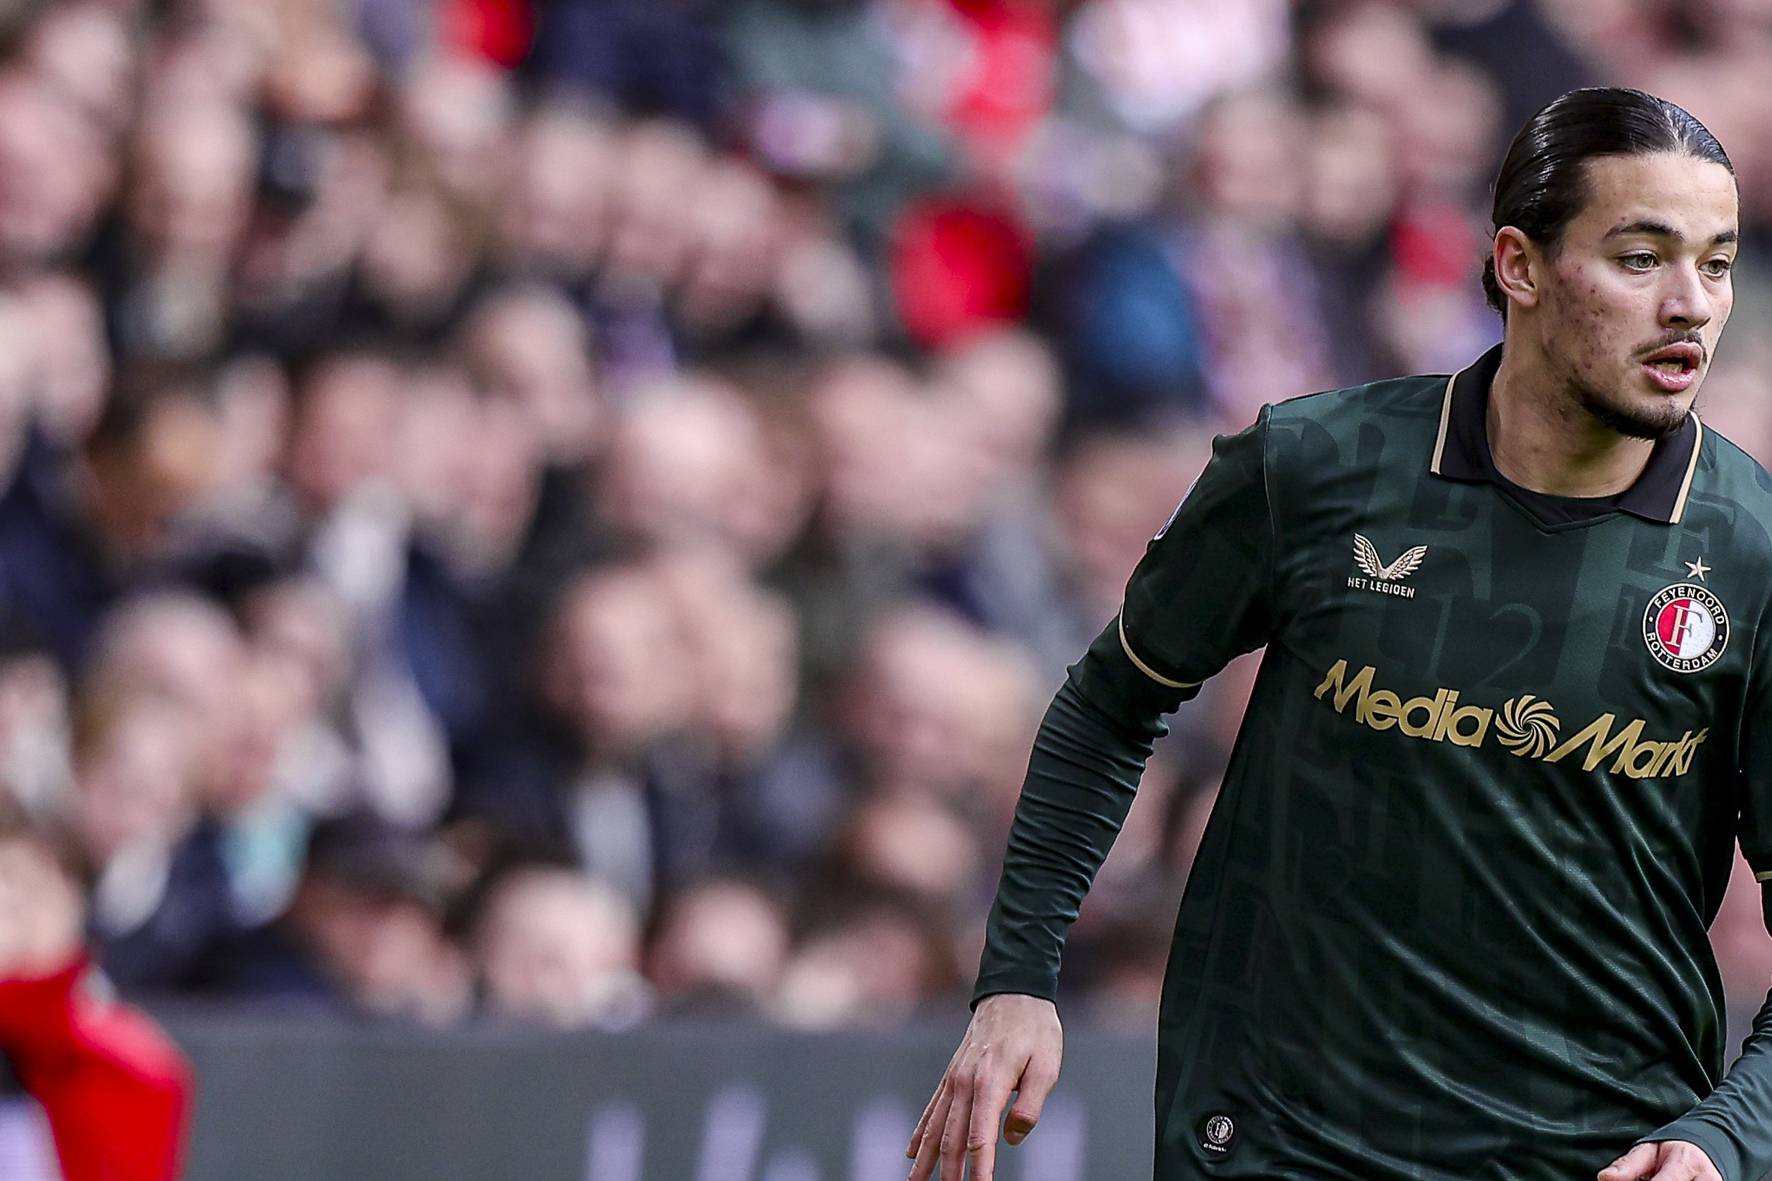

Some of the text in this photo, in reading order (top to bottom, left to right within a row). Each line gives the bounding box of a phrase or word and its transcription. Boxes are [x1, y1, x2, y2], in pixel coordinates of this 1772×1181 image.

[1347, 576, 1416, 599] HET LEGIOEN
[1654, 587, 1725, 625] FEYENOORD
[1647, 631, 1718, 670] ROTTERDAM
[1313, 658, 1709, 778] Media Markt
